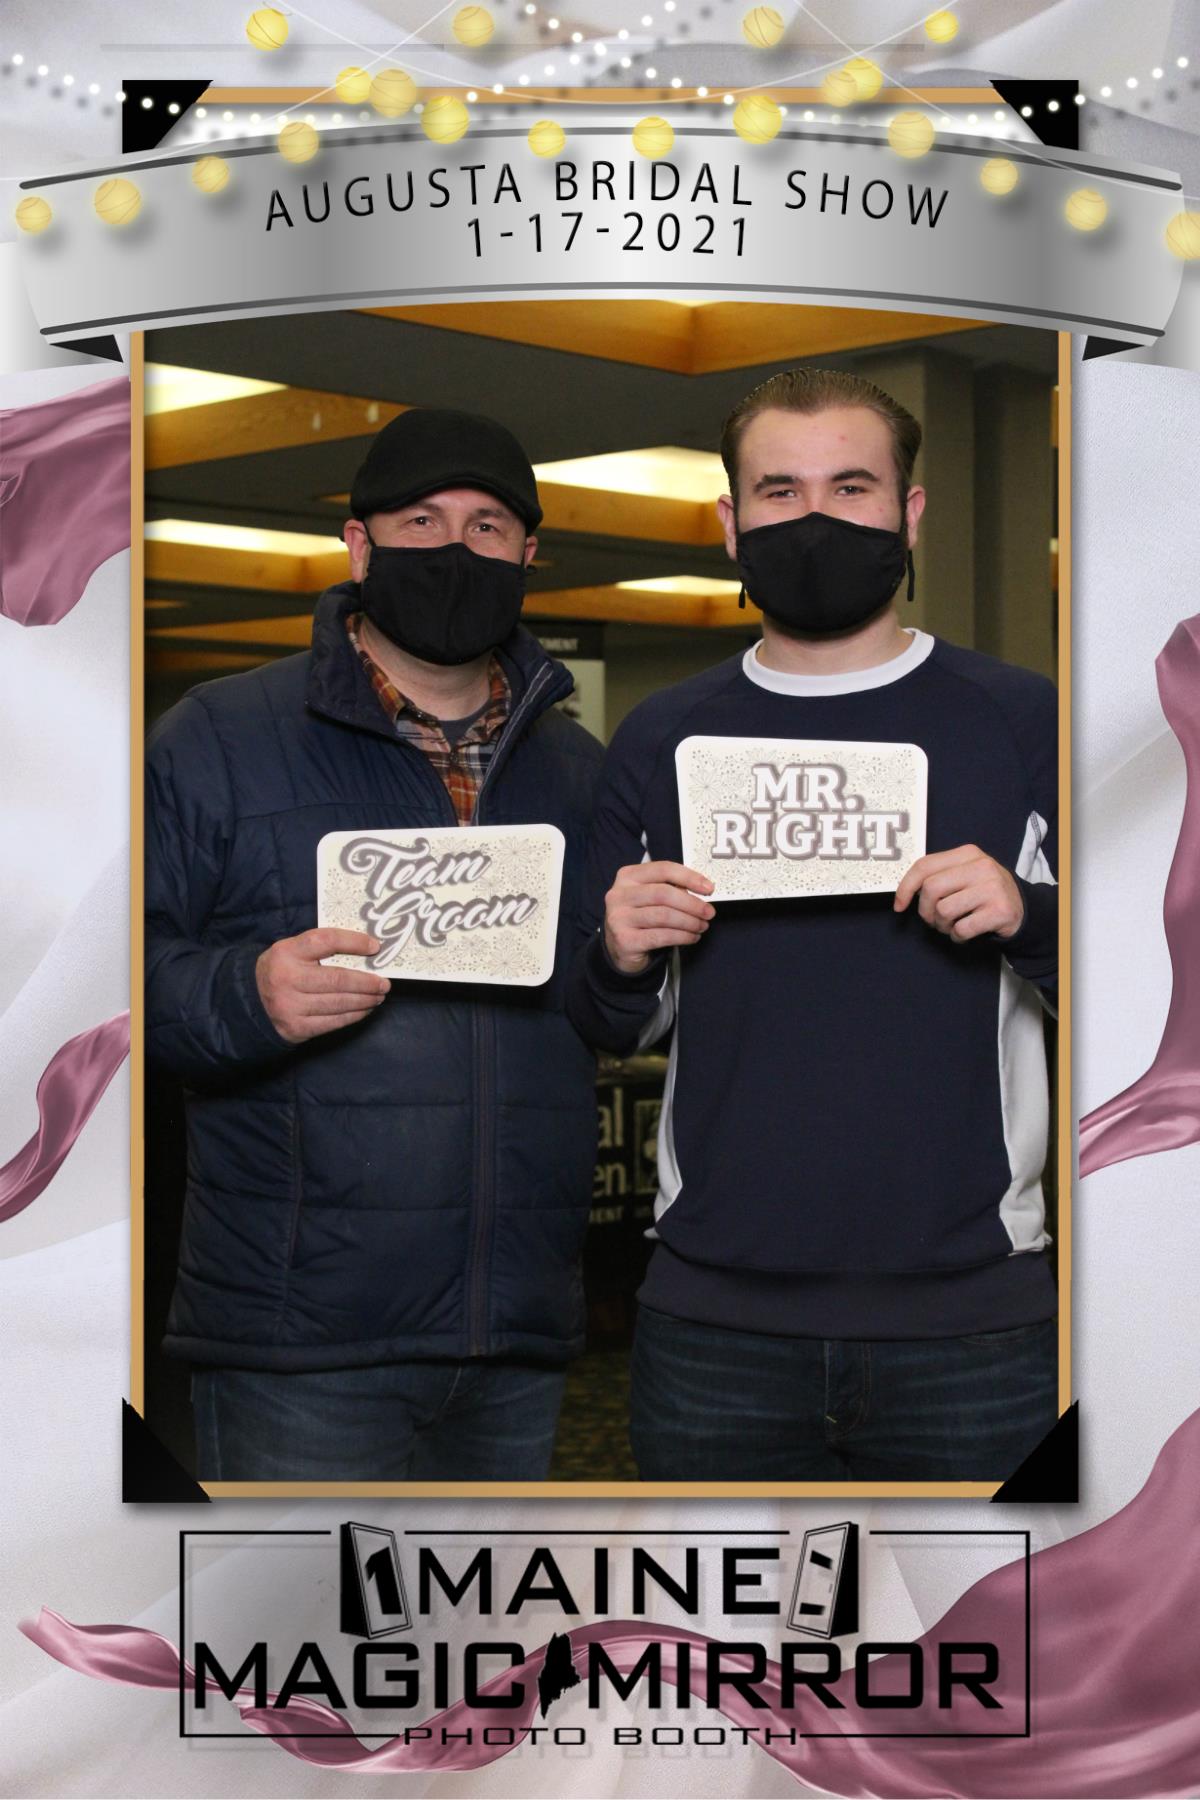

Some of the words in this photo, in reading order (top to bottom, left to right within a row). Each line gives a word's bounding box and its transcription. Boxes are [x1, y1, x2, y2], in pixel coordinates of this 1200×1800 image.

[751, 763, 866, 812] MR.
[711, 810, 909, 861] RIGHT
[340, 837, 491, 899] Team
[360, 886, 539, 970] Groom
